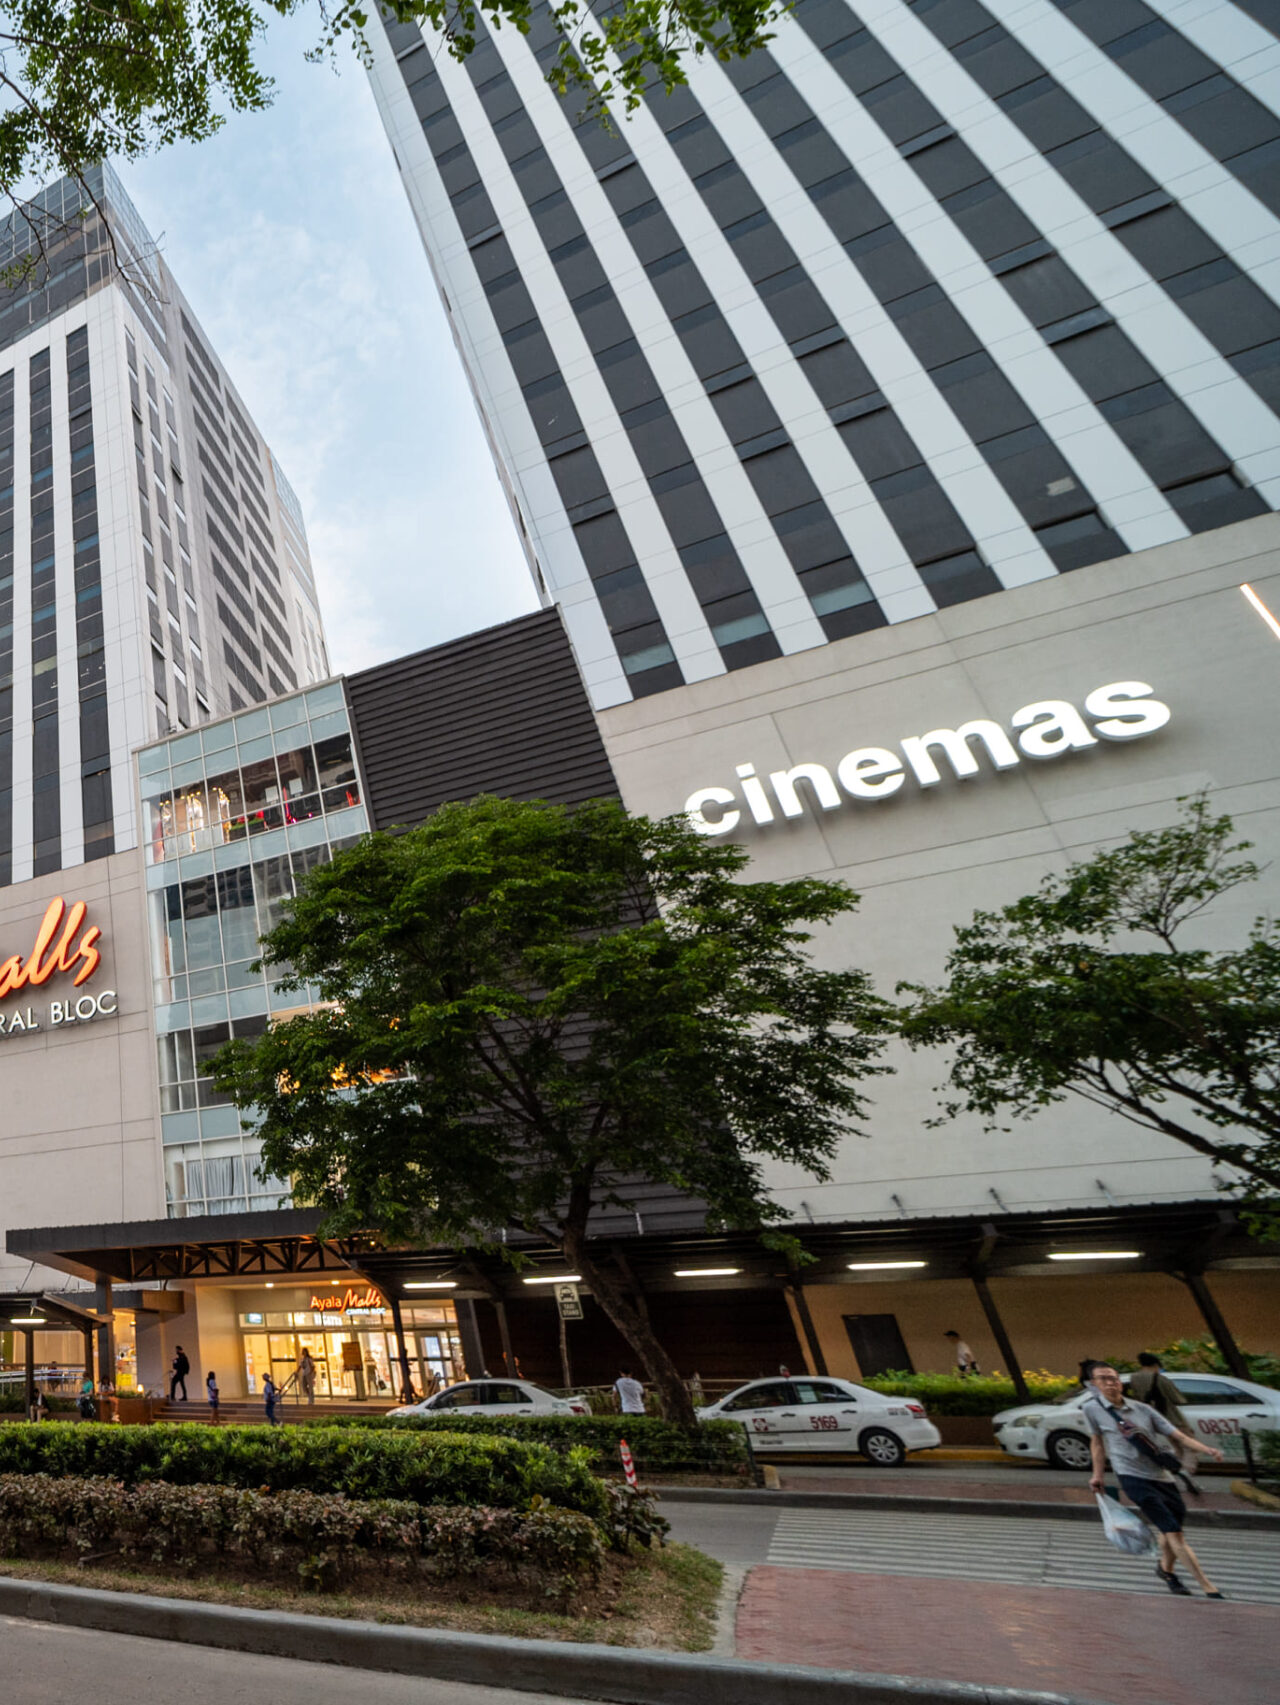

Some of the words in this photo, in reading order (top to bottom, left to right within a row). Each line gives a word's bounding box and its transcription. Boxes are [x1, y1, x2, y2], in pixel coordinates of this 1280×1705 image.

[684, 680, 1171, 837] cinemas
[50, 990, 118, 1024] BLOC
[310, 1295, 342, 1312] Ayala
[339, 1288, 381, 1315] Malls
[810, 1416, 838, 1430] 5169
[1197, 1419, 1241, 1434] 0837
